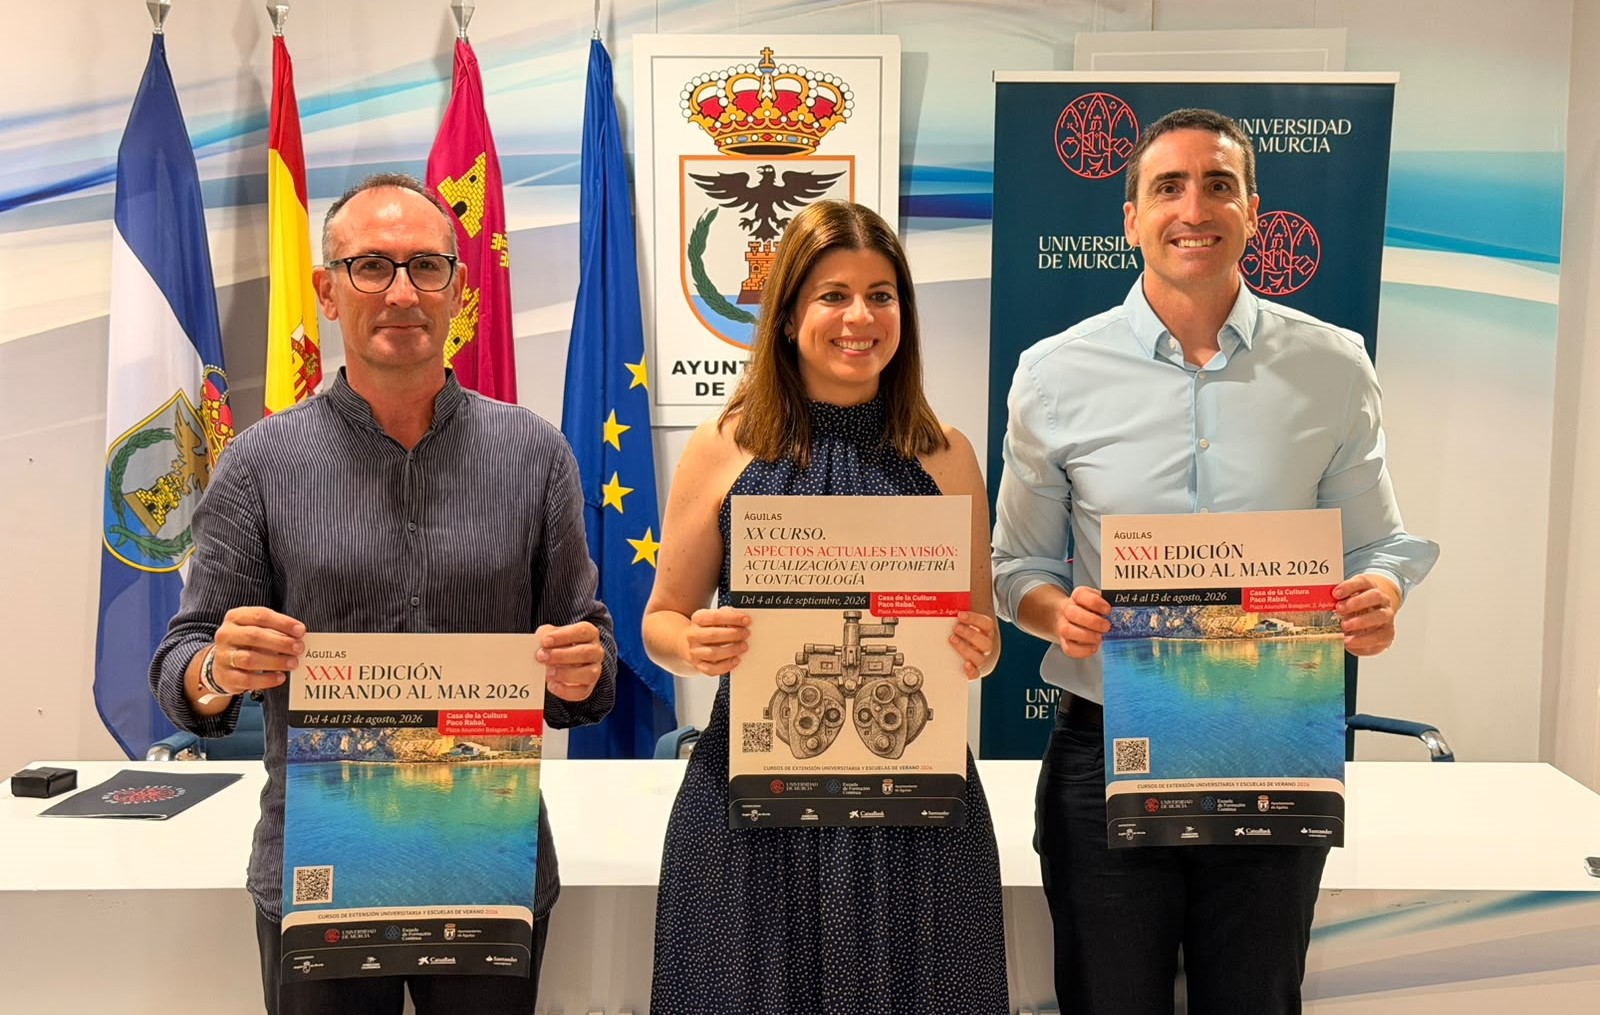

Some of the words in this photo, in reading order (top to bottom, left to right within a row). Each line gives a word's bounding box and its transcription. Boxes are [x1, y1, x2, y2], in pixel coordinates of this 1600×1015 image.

[1258, 136, 1331, 153] MURCIA
[1038, 236, 1136, 252] UNIVERSID
[1038, 254, 1063, 269] DE
[1068, 254, 1138, 269] MURCIA
[696, 382, 725, 396] DE
[744, 512, 782, 521] ÁGUILAS
[744, 527, 766, 540] XX
[770, 527, 826, 540] CURSO.
[1114, 531, 1152, 540] ÁGUILAS
[744, 546, 814, 557] ASPECTOS
[816, 546, 887, 557] ACTUALES
[890, 546, 910, 557] EN
[910, 544, 958, 557] VISIÓN:
[1114, 546, 1158, 561] XXXI
[1164, 541, 1244, 560] EDICIÓN
[743, 558, 846, 571] ACTUALIZACIÓN
[850, 560, 868, 571] EN
[870, 558, 955, 571] OPTOMETRÍA
[1114, 563, 1206, 579] MIRANDO
[1210, 563, 1236, 578] AL
[1240, 561, 1282, 577] MAR
[1286, 560, 1329, 576] 2026
[744, 574, 753, 585] Y
[755, 572, 865, 585] CONTACTOLOGÍA
[740, 595, 757, 605] Del
[758, 596, 764, 604] 4
[765, 596, 774, 604] al
[775, 596, 781, 604] 6
[782, 596, 794, 604] de
[795, 596, 842, 606] septiembre,
[843, 596, 866, 604] 2026
[1115, 593, 1131, 603] Del
[1131, 594, 1138, 602] 4
[1139, 593, 1149, 602] al
[1150, 593, 1160, 602] 13
[1160, 593, 1170, 602] de
[1171, 594, 1202, 604] agosto,
[1204, 592, 1227, 602] 2026
[305, 650, 347, 659] ÁGUILAS
[305, 665, 352, 681] XXXI
[358, 662, 443, 681] EDICIÓN
[304, 684, 402, 700] MIRANDO
[406, 684, 432, 699] AL
[437, 684, 481, 699] MAR
[485, 683, 530, 699] 2026
[1025, 705, 1048, 719] DE
[303, 714, 320, 724] Del
[321, 715, 328, 724] 4
[330, 714, 340, 724] al
[341, 714, 352, 724] 13
[352, 714, 365, 724] de
[366, 716, 398, 726] agosto,
[399, 714, 423, 724] 2026
